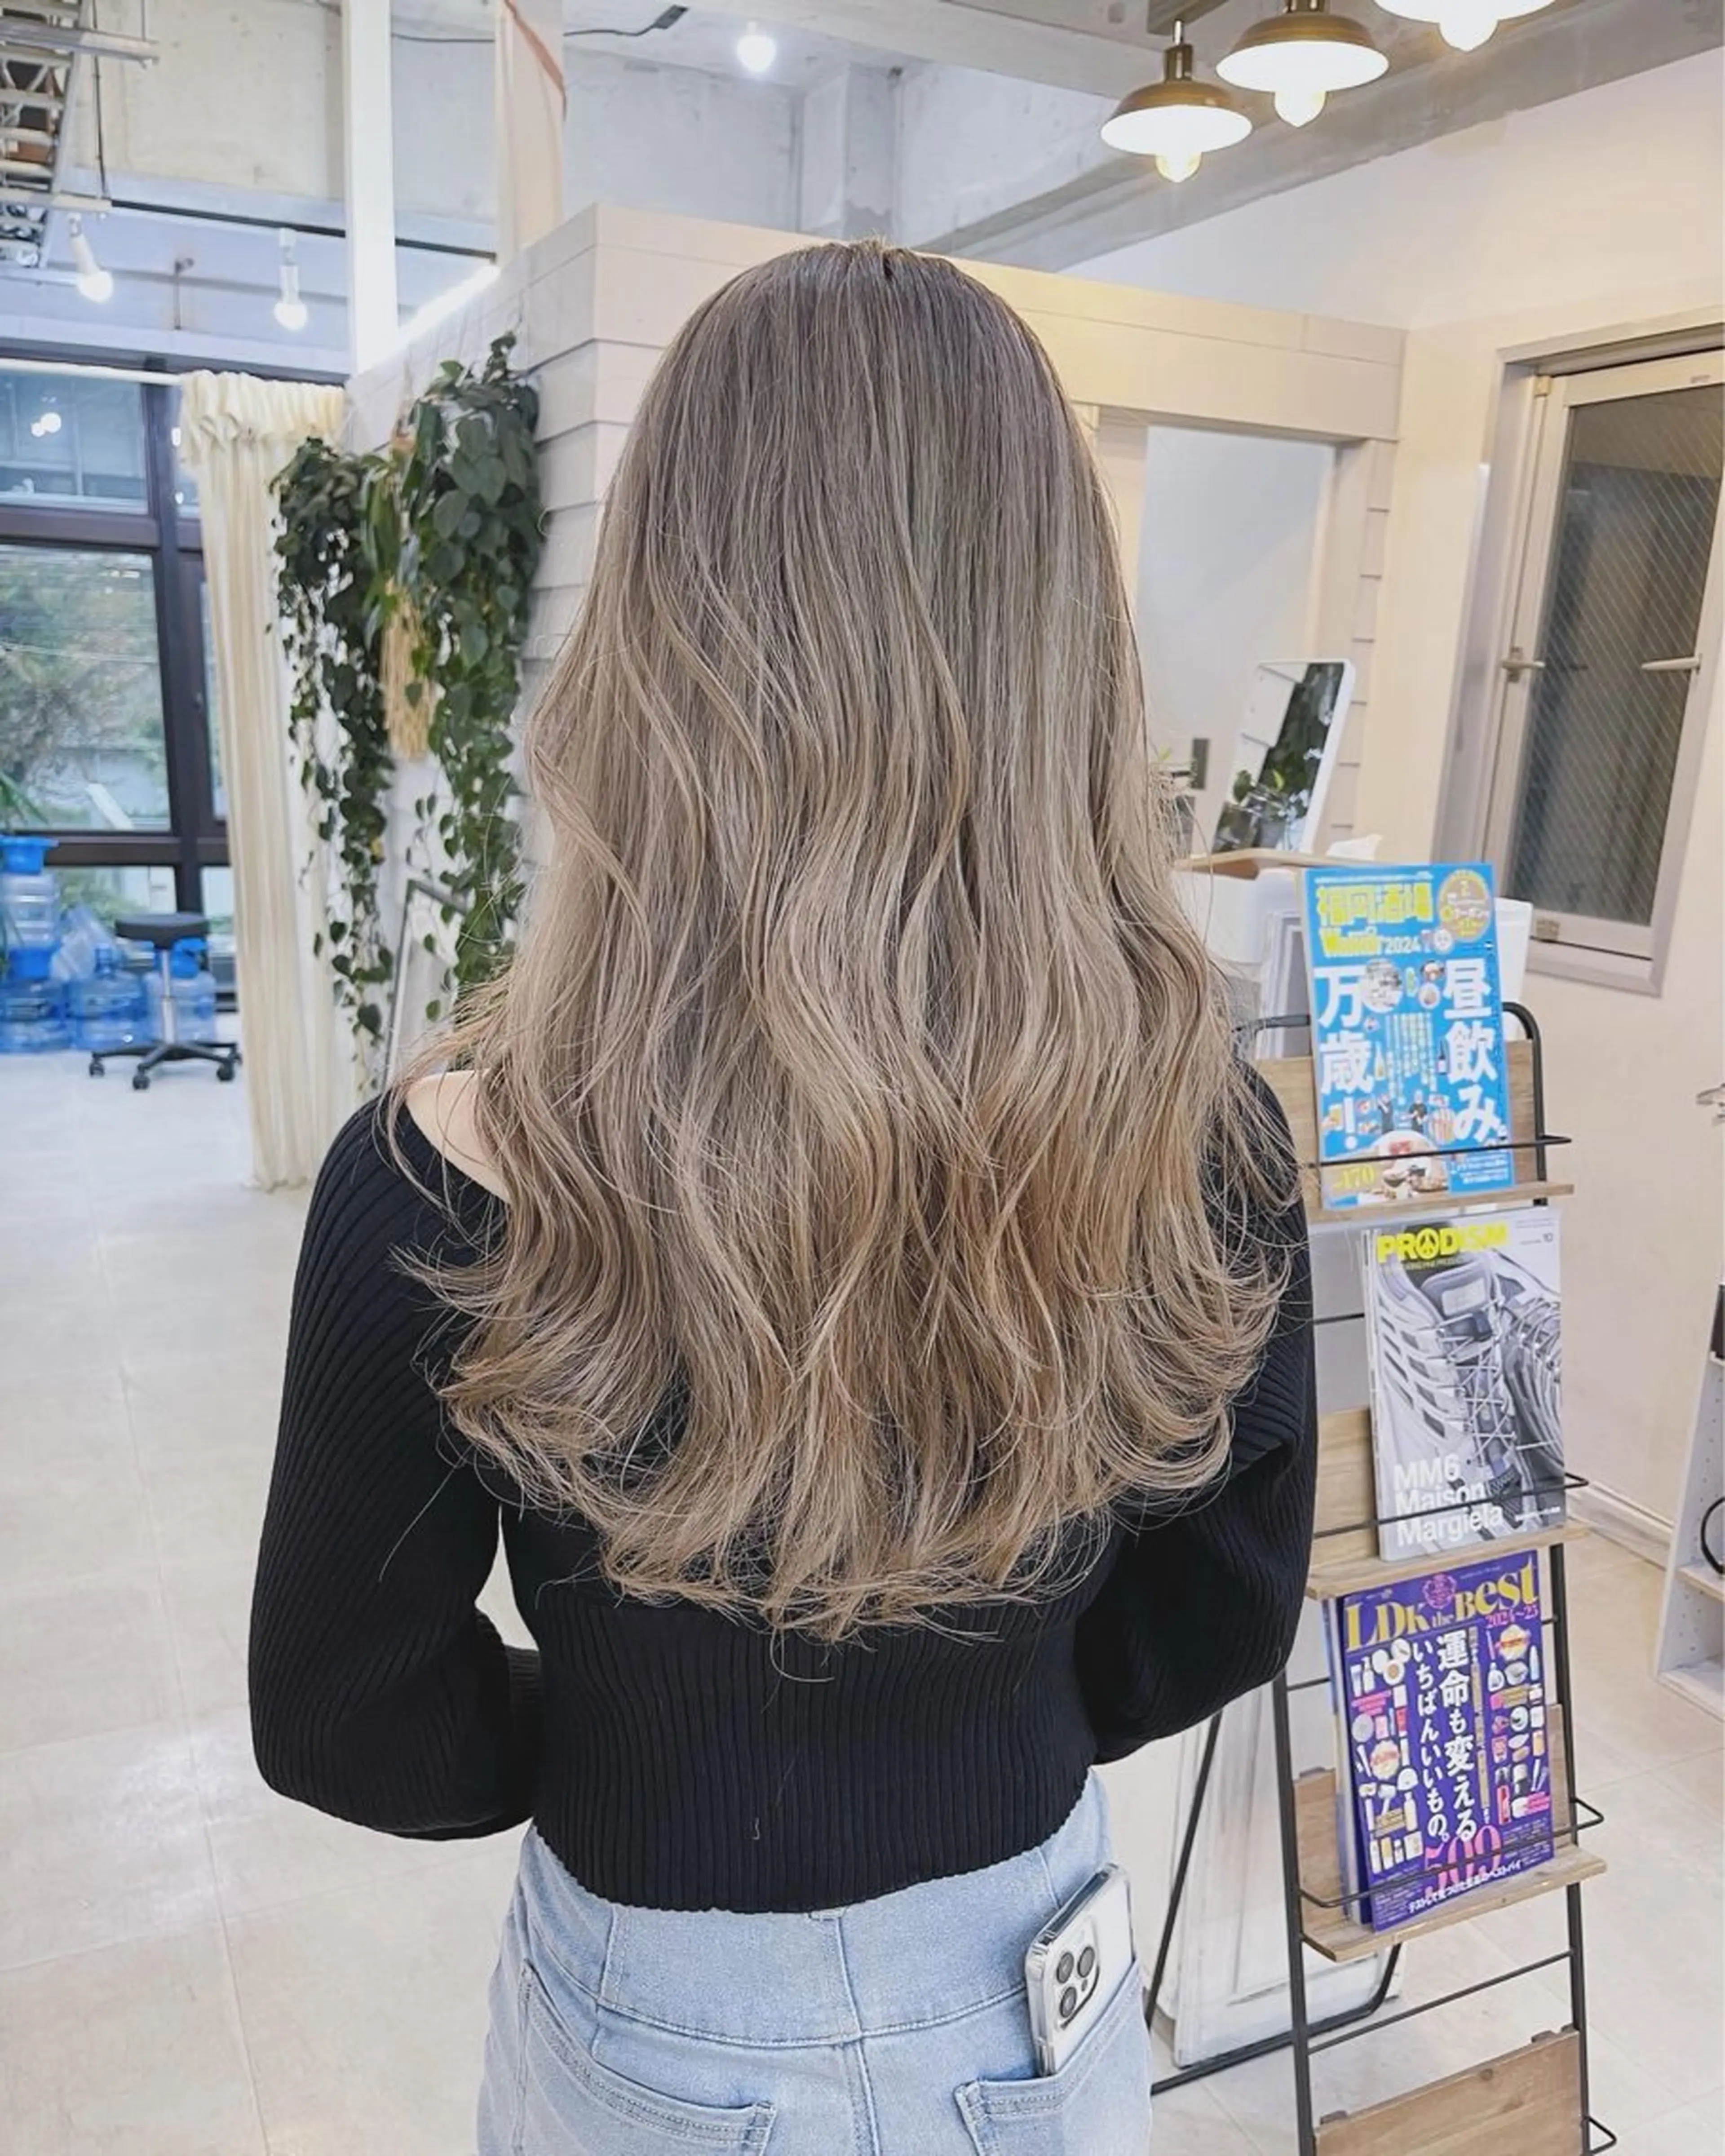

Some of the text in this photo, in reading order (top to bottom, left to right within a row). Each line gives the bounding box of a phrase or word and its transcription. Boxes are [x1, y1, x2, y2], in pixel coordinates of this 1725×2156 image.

[1442, 958, 1501, 1143] 昼飲み
[1394, 1452, 1461, 1491] MM6
[1395, 1481, 1486, 1517] Maison
[1397, 1501, 1503, 1546] Margiela
[1345, 1601, 1429, 1652] LDK
[1432, 1610, 1455, 1627] the
[1412, 1640, 1450, 1843] いちばんいいもの。
[1436, 1629, 1477, 1843] 運命も変える
